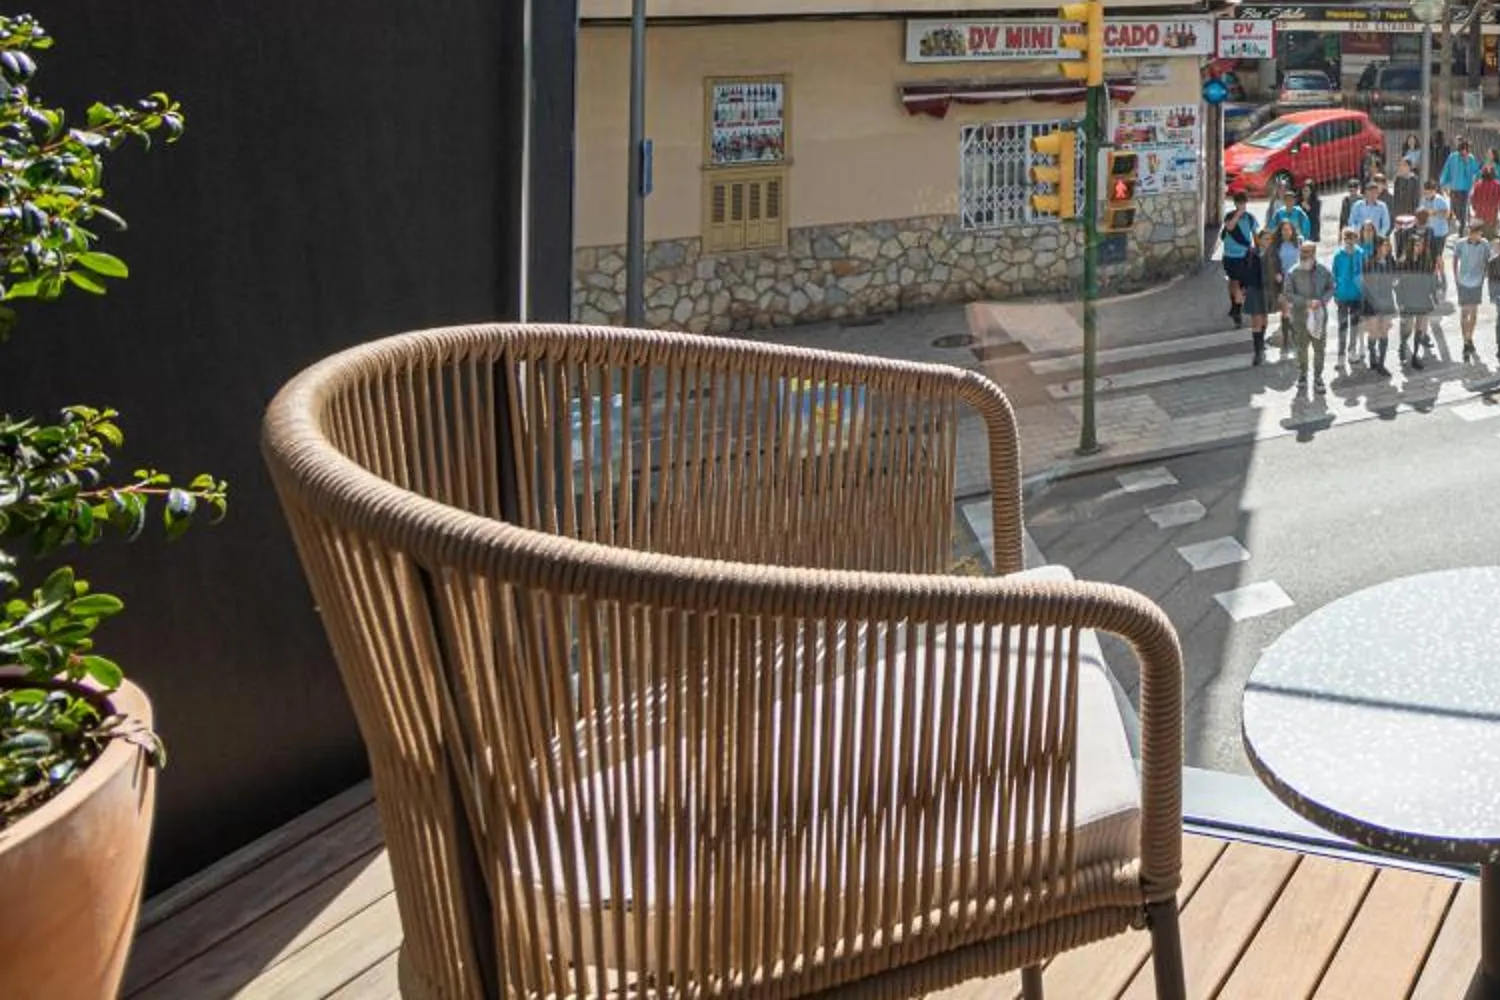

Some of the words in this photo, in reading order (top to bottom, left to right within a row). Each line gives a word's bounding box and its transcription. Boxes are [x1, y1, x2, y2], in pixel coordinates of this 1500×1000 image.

[967, 26, 999, 50] DV
[1005, 24, 1053, 49] MINI
[1060, 23, 1160, 47] CADO
[1233, 22, 1255, 34] DV
